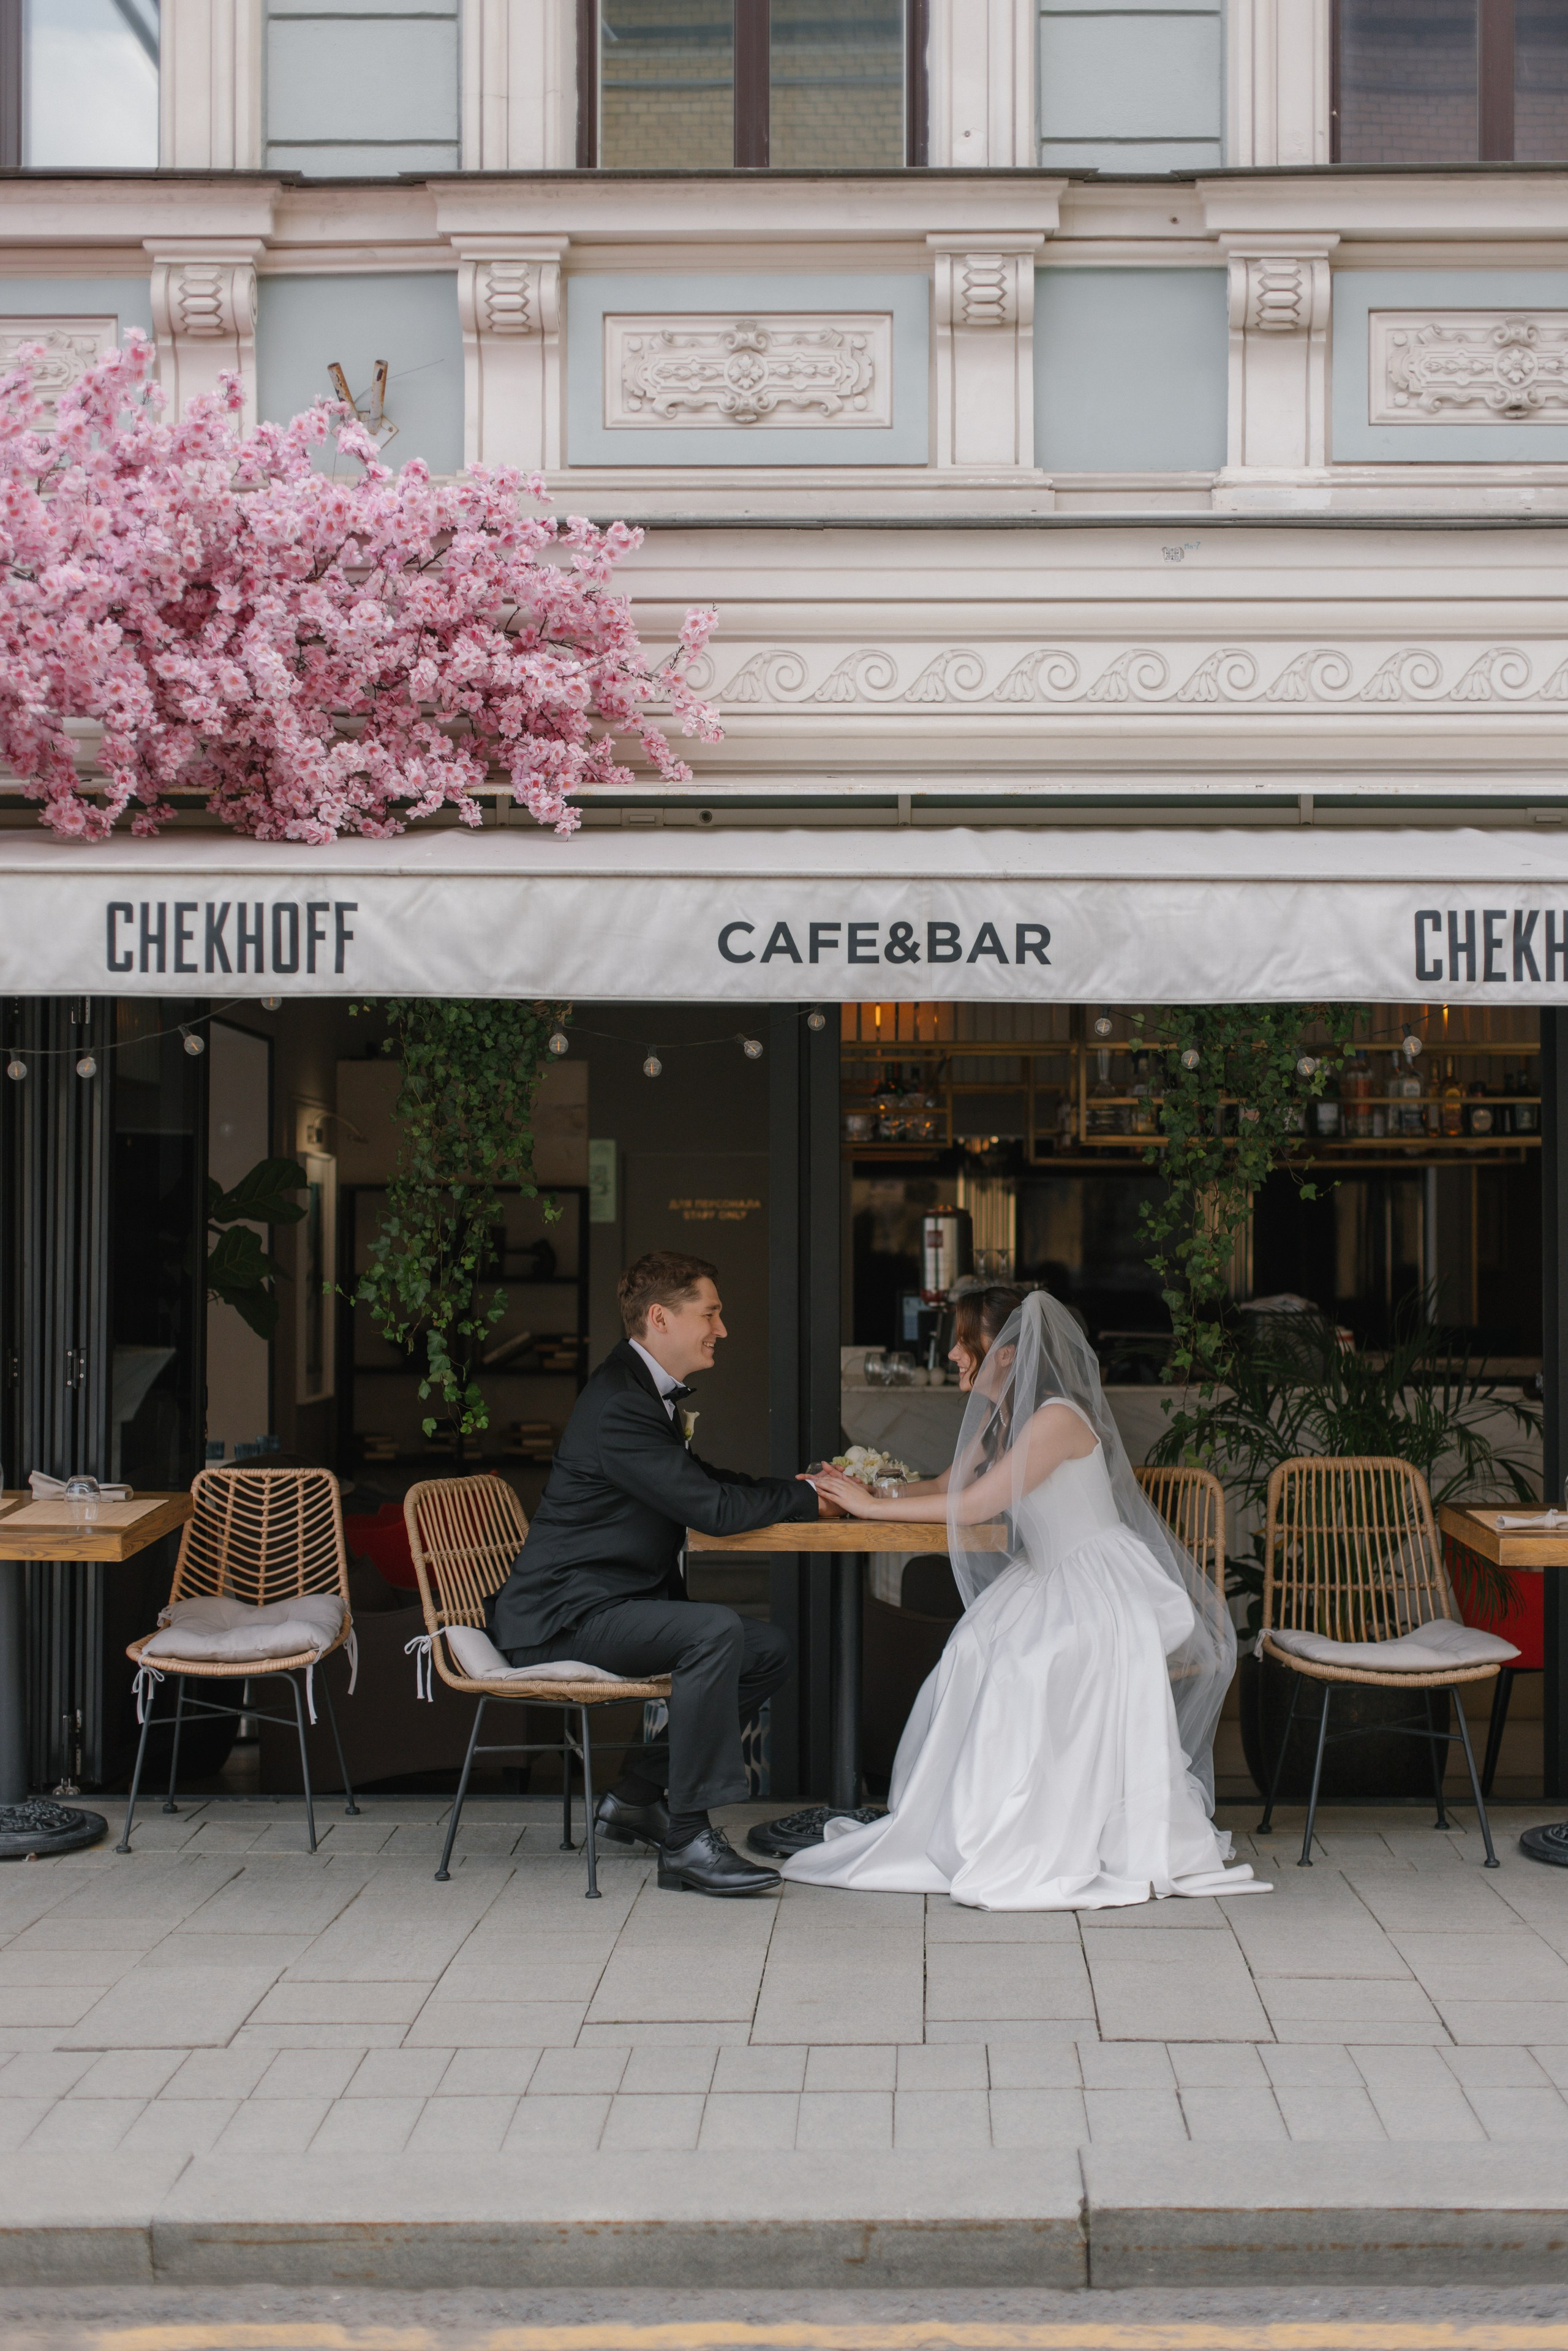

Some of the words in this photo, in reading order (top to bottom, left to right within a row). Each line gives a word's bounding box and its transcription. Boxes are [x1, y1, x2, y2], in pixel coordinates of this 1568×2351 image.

[107, 902, 358, 974] CHEKHOFF
[718, 921, 1052, 965] CAFE&BAR
[1414, 910, 1568, 982] CHEKH
